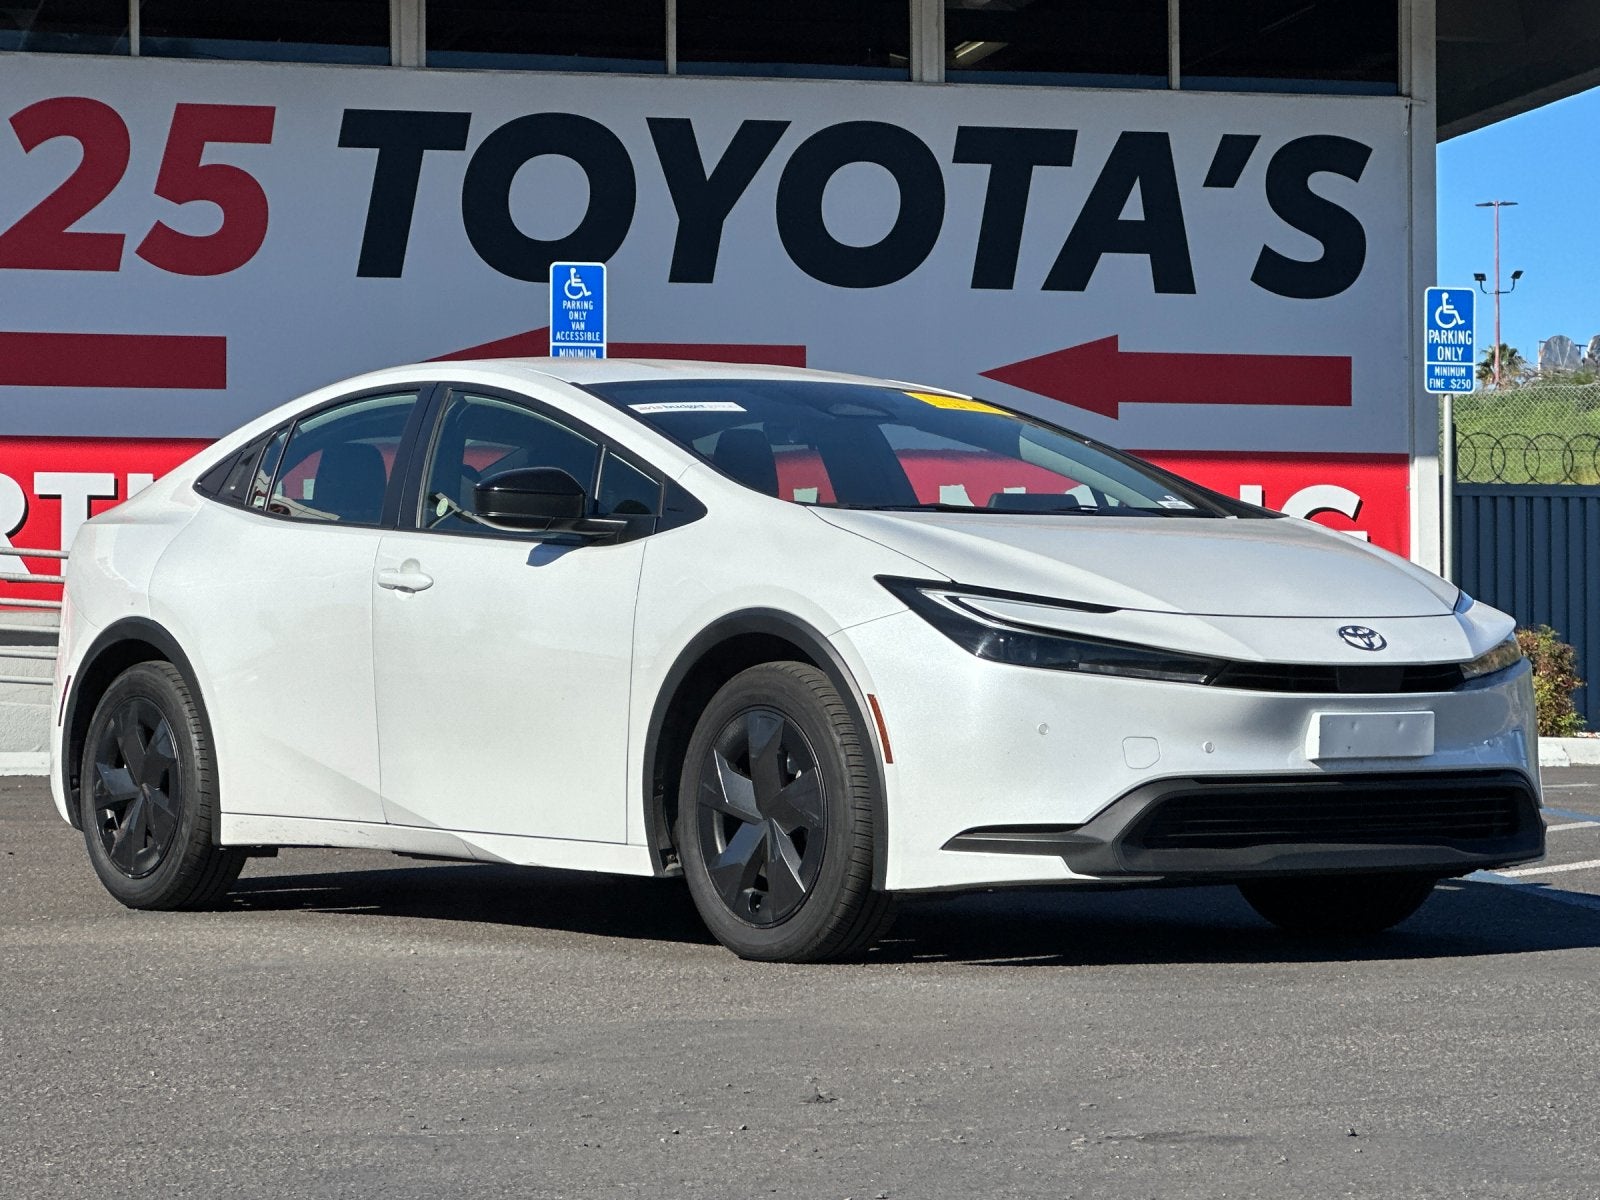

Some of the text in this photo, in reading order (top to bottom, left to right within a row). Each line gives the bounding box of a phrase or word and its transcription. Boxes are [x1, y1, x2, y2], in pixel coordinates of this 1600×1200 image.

[337, 108, 1373, 300] TOYOTA'S
[562, 300, 594, 311] PARKING
[568, 310, 587, 321] ONLY
[571, 321, 585, 331] VAN
[555, 331, 601, 342] ACCESSIBLE
[1428, 329, 1472, 346] PARKING
[559, 347, 597, 358] MINIMUM
[1437, 346, 1464, 362] ONLY
[1434, 366, 1466, 377] MINIMUM
[1429, 378, 1472, 390] FINE $250
